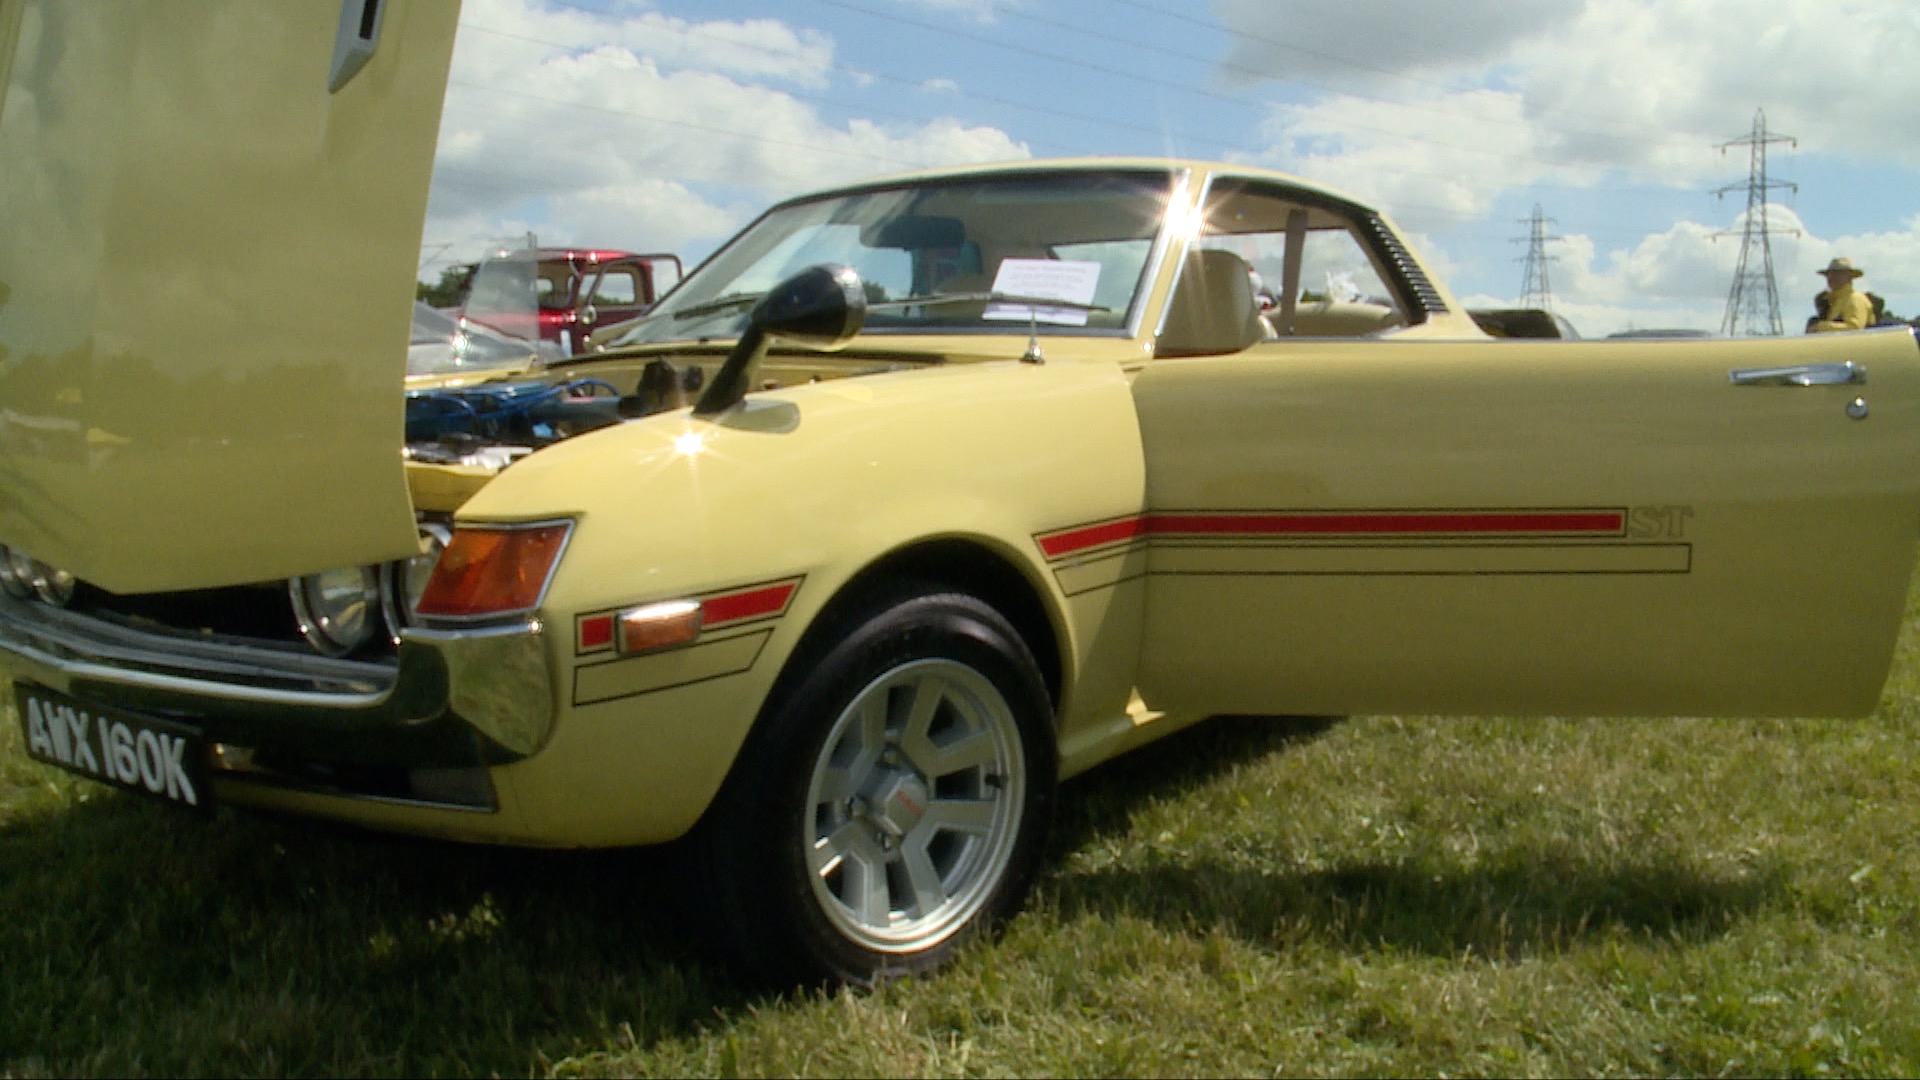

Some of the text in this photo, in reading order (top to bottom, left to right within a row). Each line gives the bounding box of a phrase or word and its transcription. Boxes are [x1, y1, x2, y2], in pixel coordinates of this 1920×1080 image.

[1630, 504, 1694, 537] ST
[28, 697, 197, 806] AWX 160K
